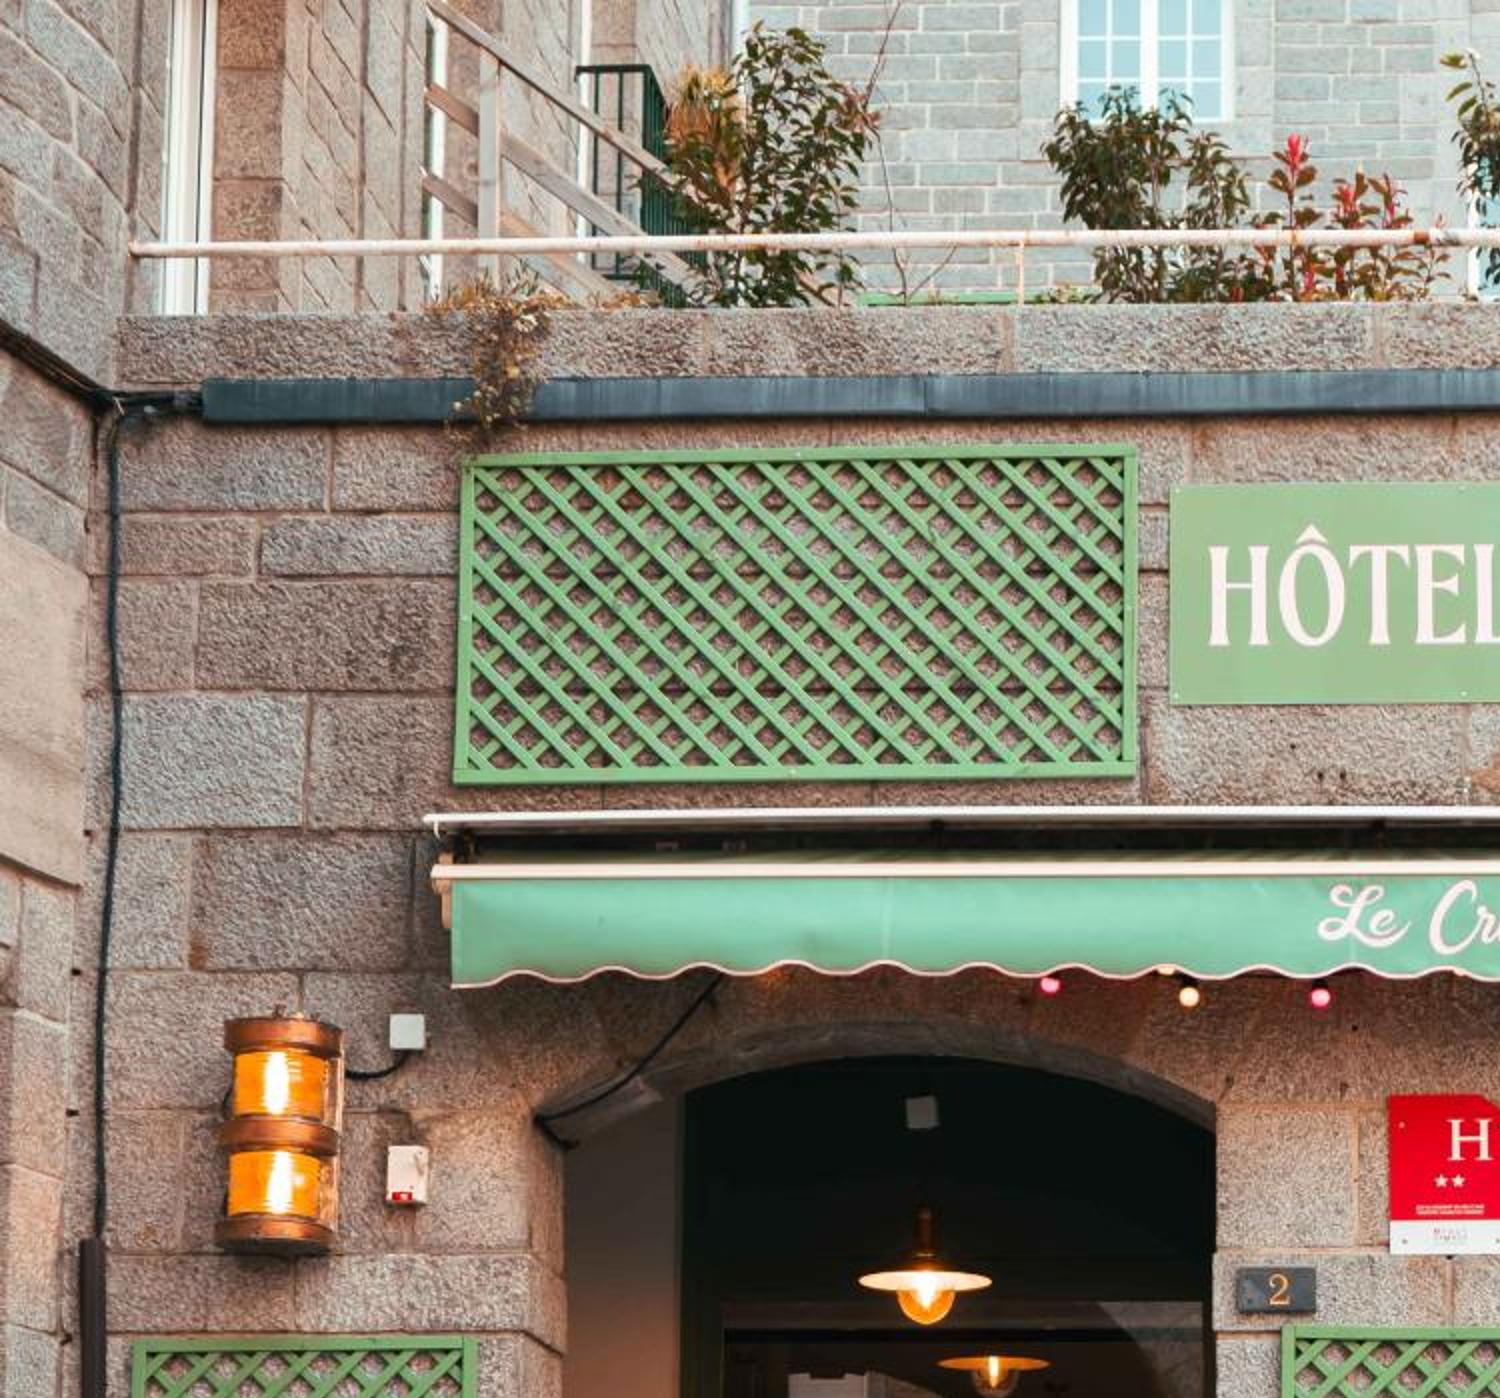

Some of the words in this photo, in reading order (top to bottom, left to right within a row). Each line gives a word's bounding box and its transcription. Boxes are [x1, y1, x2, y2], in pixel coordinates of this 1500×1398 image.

[1317, 884, 1411, 948] Le
[1446, 1118, 1494, 1161] H
[1268, 1273, 1291, 1306] 2
